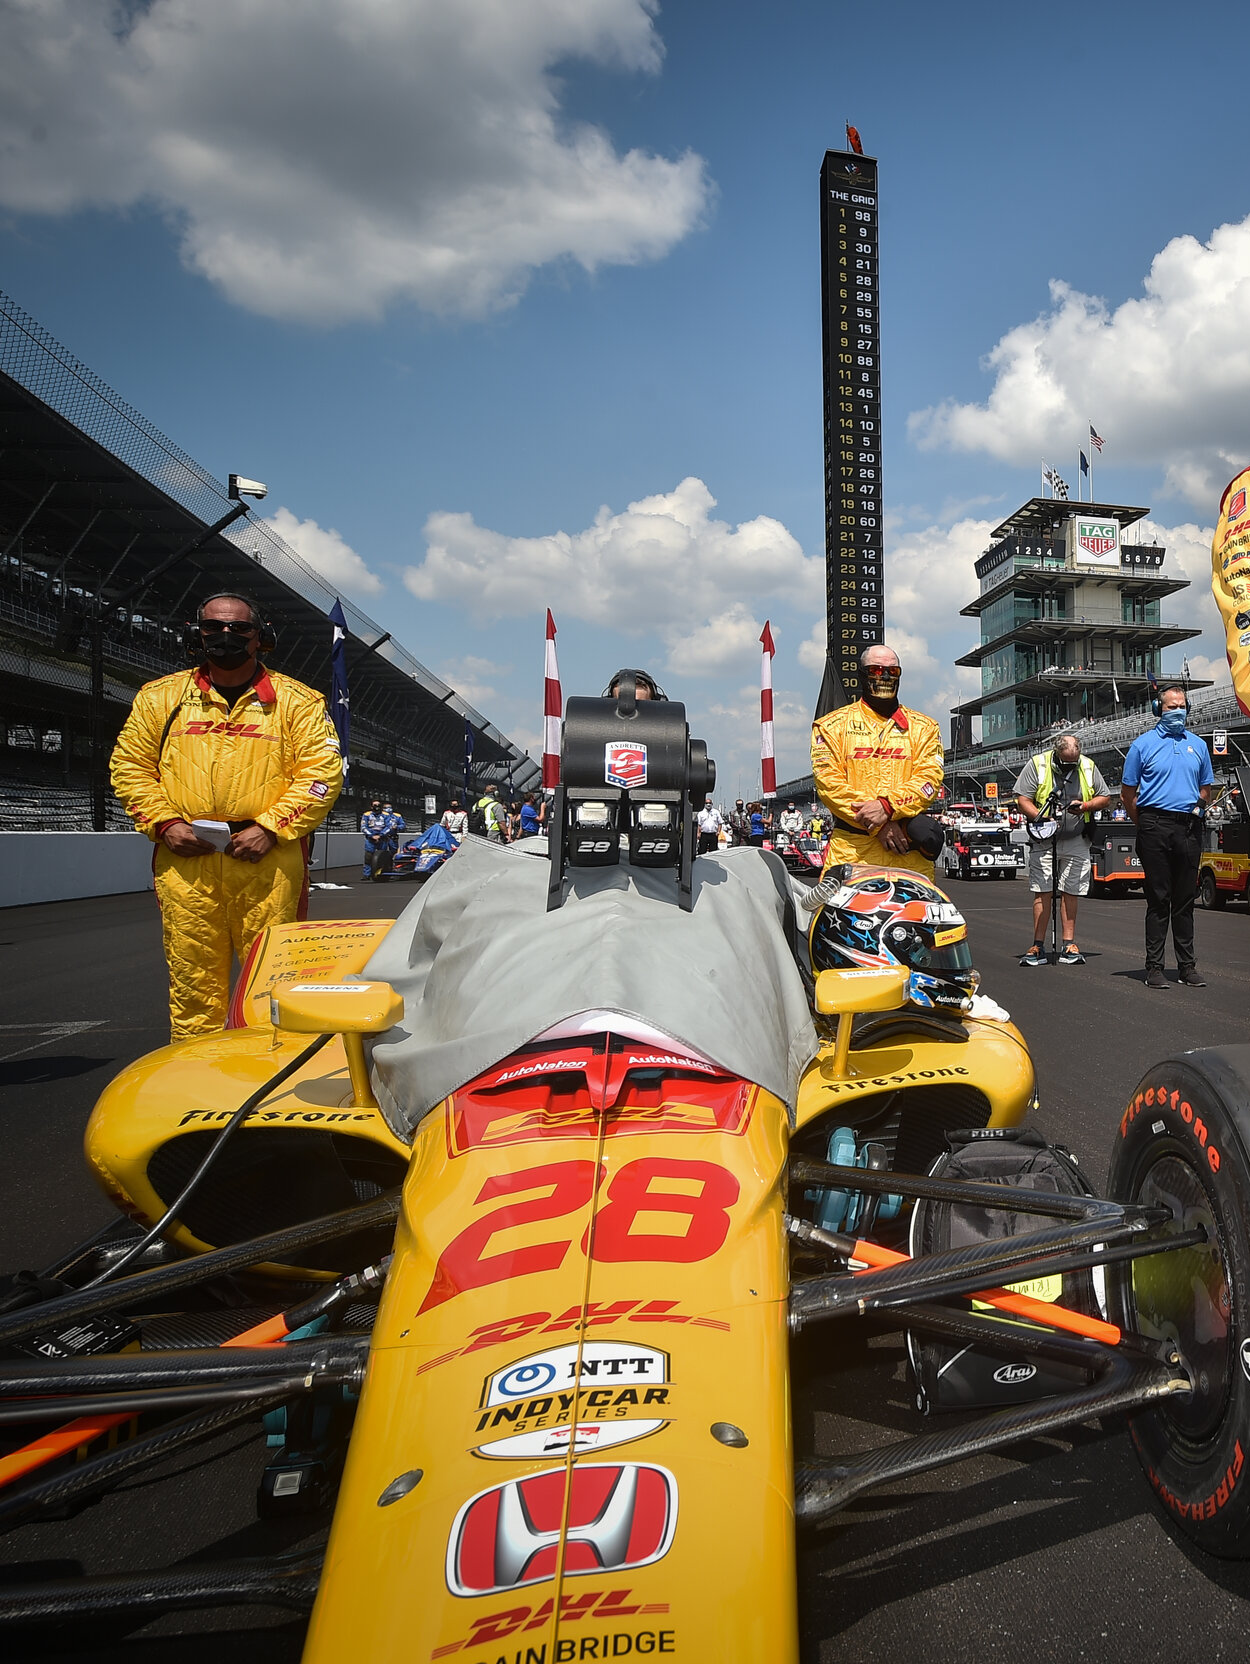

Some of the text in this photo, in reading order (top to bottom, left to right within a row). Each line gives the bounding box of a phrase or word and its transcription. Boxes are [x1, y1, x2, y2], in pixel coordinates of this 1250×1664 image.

[830, 189, 875, 206] THE GRID
[839, 207, 871, 222] 1 98
[839, 223, 867, 237] 2 9
[839, 240, 872, 254] 3 30
[839, 256, 870, 270] 4 21
[839, 272, 872, 286] 5 28
[839, 288, 872, 302] 6 29
[840, 304, 873, 319] 7 55
[840, 321, 872, 334] 8 15
[840, 337, 872, 350] 9 27
[838, 353, 873, 367] 10 88
[838, 369, 870, 382] 11 8
[838, 385, 874, 399] 12 45
[839, 402, 869, 414] 13 1
[839, 418, 874, 431] 14 10
[839, 434, 871, 447] 15 5
[840, 450, 875, 463] 16 20
[840, 466, 875, 479] 17 26
[840, 482, 875, 495] 18 47
[840, 499, 875, 511] 19 18
[839, 515, 876, 527] 20 60
[840, 531, 872, 543] 21 7
[1082, 525, 1113, 537] TAG
[840, 547, 876, 560] 22 12
[1015, 545, 1053, 557] 1 2 3 4
[1080, 538, 1115, 556] HEUER
[1125, 554, 1160, 565] 5 6 7 8
[840, 564, 876, 576] 23 14
[840, 580, 875, 592] 24 41
[1231, 584, 1245, 599] US
[841, 596, 877, 608] 25 22
[841, 612, 877, 624] 26 66
[841, 629, 876, 640] 27 51
[841, 645, 858, 655] 28
[841, 661, 858, 672] 29
[842, 677, 858, 688] 30
[182, 720, 266, 739] DHL
[1214, 735, 1226, 745] 30
[852, 746, 907, 760] DHL
[986, 784, 996, 796] 28
[577, 841, 611, 853] 28
[637, 842, 671, 854] 28
[994, 852, 1016, 861] United
[994, 858, 1018, 866] Rentals
[279, 931, 376, 945] AutoNation
[265, 971, 330, 987] CONCRETE
[269, 970, 298, 981] US
[495, 1059, 588, 1083] AutoNation
[628, 1055, 716, 1074] AutoNation
[821, 1065, 970, 1093] Firestone
[1119, 1085, 1221, 1175] Firestone
[414, 1157, 741, 1318] 28
[450, 1299, 702, 1360] DHL
[567, 1357, 654, 1378] NTT
[996, 1364, 1034, 1380] Arai
[474, 1388, 671, 1432] INDYCAR
[513, 1405, 628, 1432] SERIES
[455, 1588, 648, 1652] DHL
